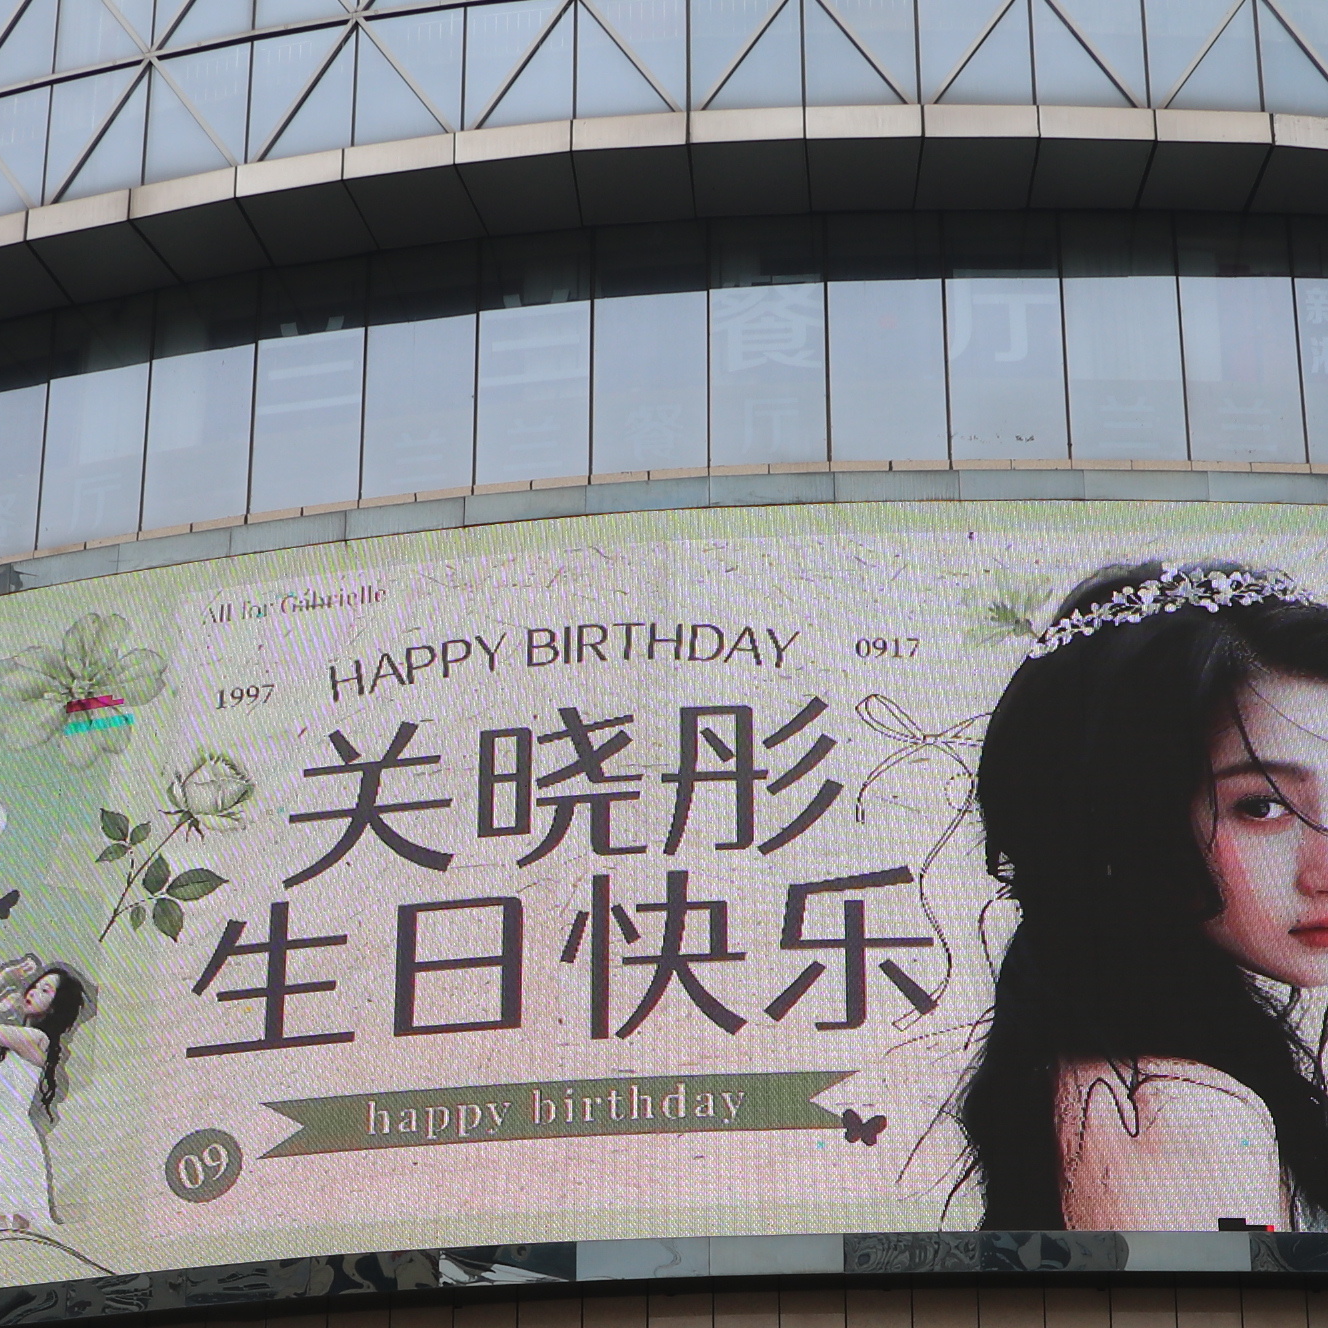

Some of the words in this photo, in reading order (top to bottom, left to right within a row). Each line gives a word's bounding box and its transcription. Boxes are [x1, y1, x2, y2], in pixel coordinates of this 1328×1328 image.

[328, 631, 508, 702] HAPPY
[524, 621, 801, 669] BIRTHDAY
[855, 636, 920, 660] 0917
[215, 682, 275, 710] 1997
[282, 695, 845, 890] 关晓彤
[185, 866, 937, 1059] 生日快乐
[366, 1092, 512, 1139] happy
[531, 1083, 749, 1126] birthday
[175, 1143, 231, 1193] 09
